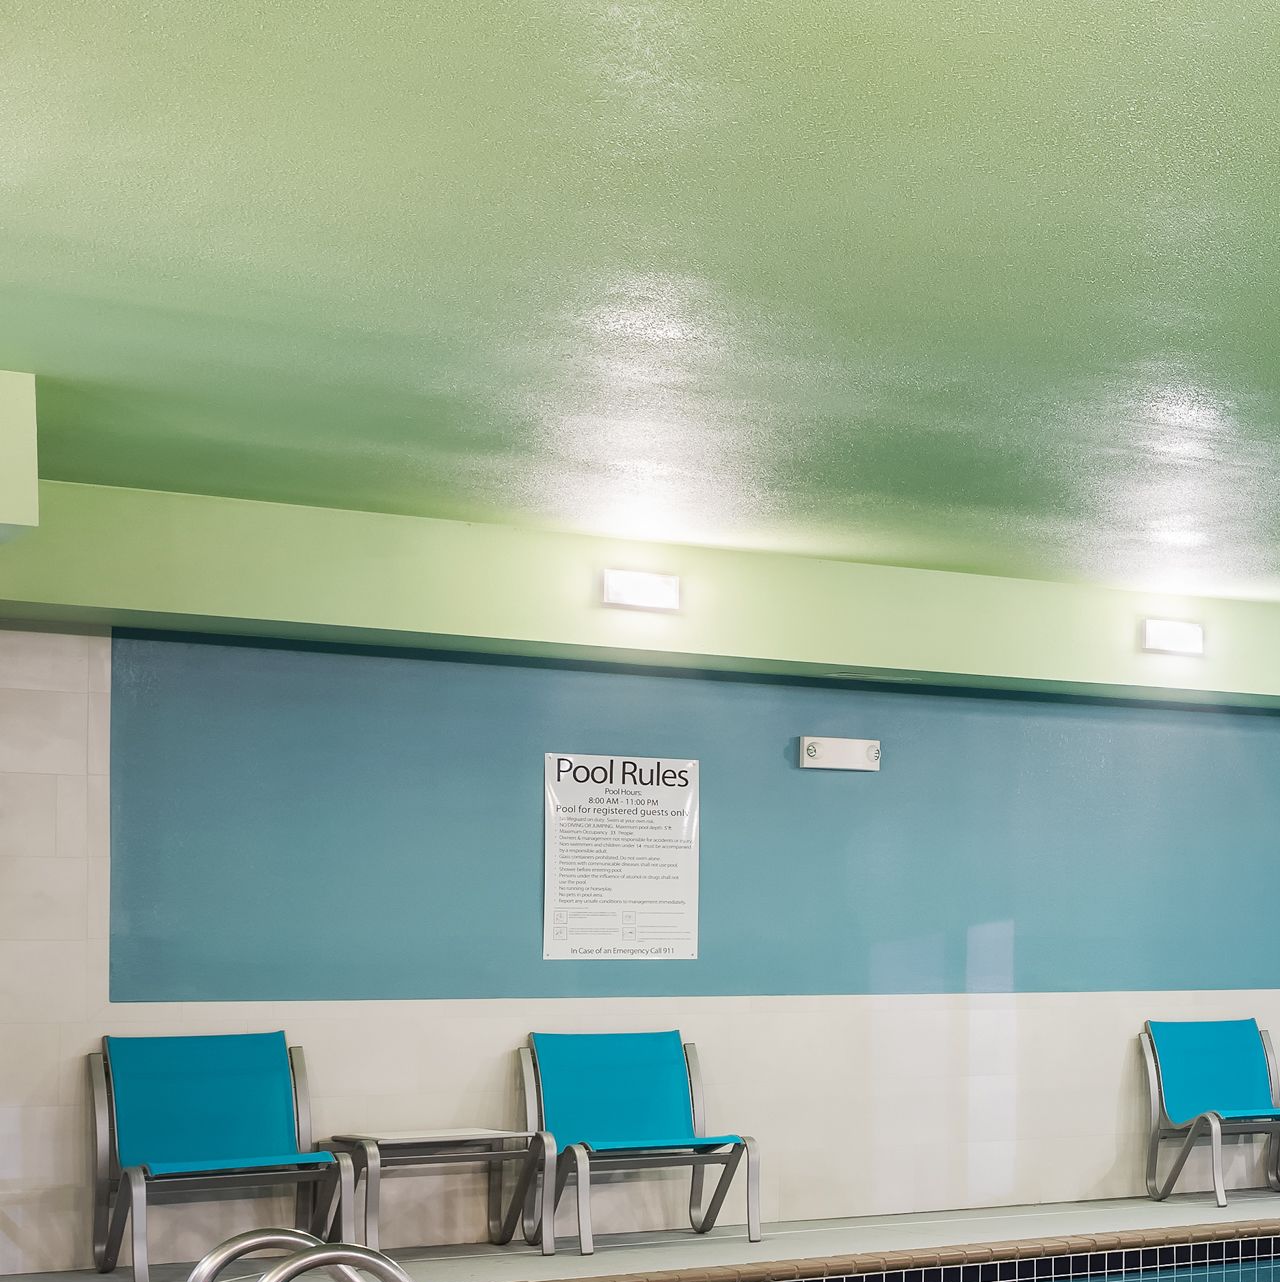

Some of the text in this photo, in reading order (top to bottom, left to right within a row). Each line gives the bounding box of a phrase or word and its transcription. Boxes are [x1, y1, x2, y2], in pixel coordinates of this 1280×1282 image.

[556, 758, 689, 787] Pool Rules
[556, 804, 576, 813] Pool
[579, 805, 590, 813] for
[593, 806, 638, 816] registered
[640, 809, 668, 818] guests
[613, 948, 649, 956] Emergency
